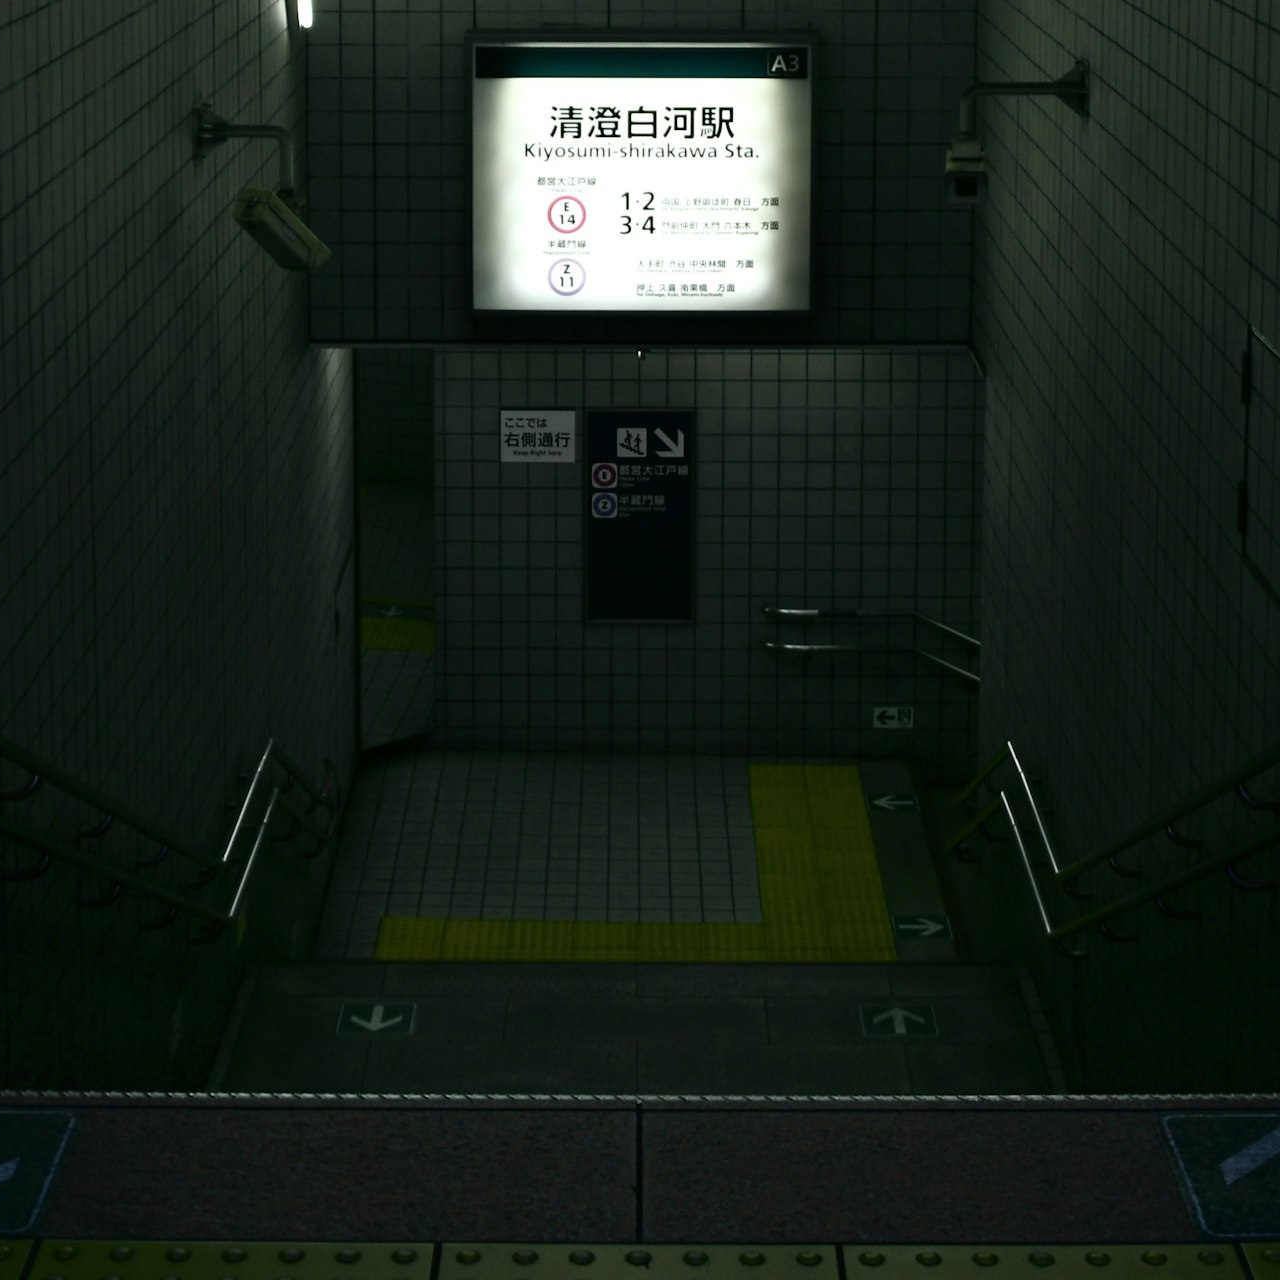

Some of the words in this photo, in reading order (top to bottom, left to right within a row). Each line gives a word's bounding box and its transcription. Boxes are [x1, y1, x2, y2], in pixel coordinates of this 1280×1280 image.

[770, 53, 800, 72] A3
[549, 105, 735, 140] 清澄白河駅
[524, 141, 718, 162] Kiyosumi-shirakawa
[724, 142, 760, 159] Sta.
[563, 201, 570, 212] E
[559, 213, 576, 225] 14
[563, 263, 571, 275] Z
[559, 276, 574, 288] 11
[504, 417, 548, 428] ここでは
[504, 431, 571, 448] 右側通行
[602, 471, 608, 480] E
[601, 501, 609, 510] Z
